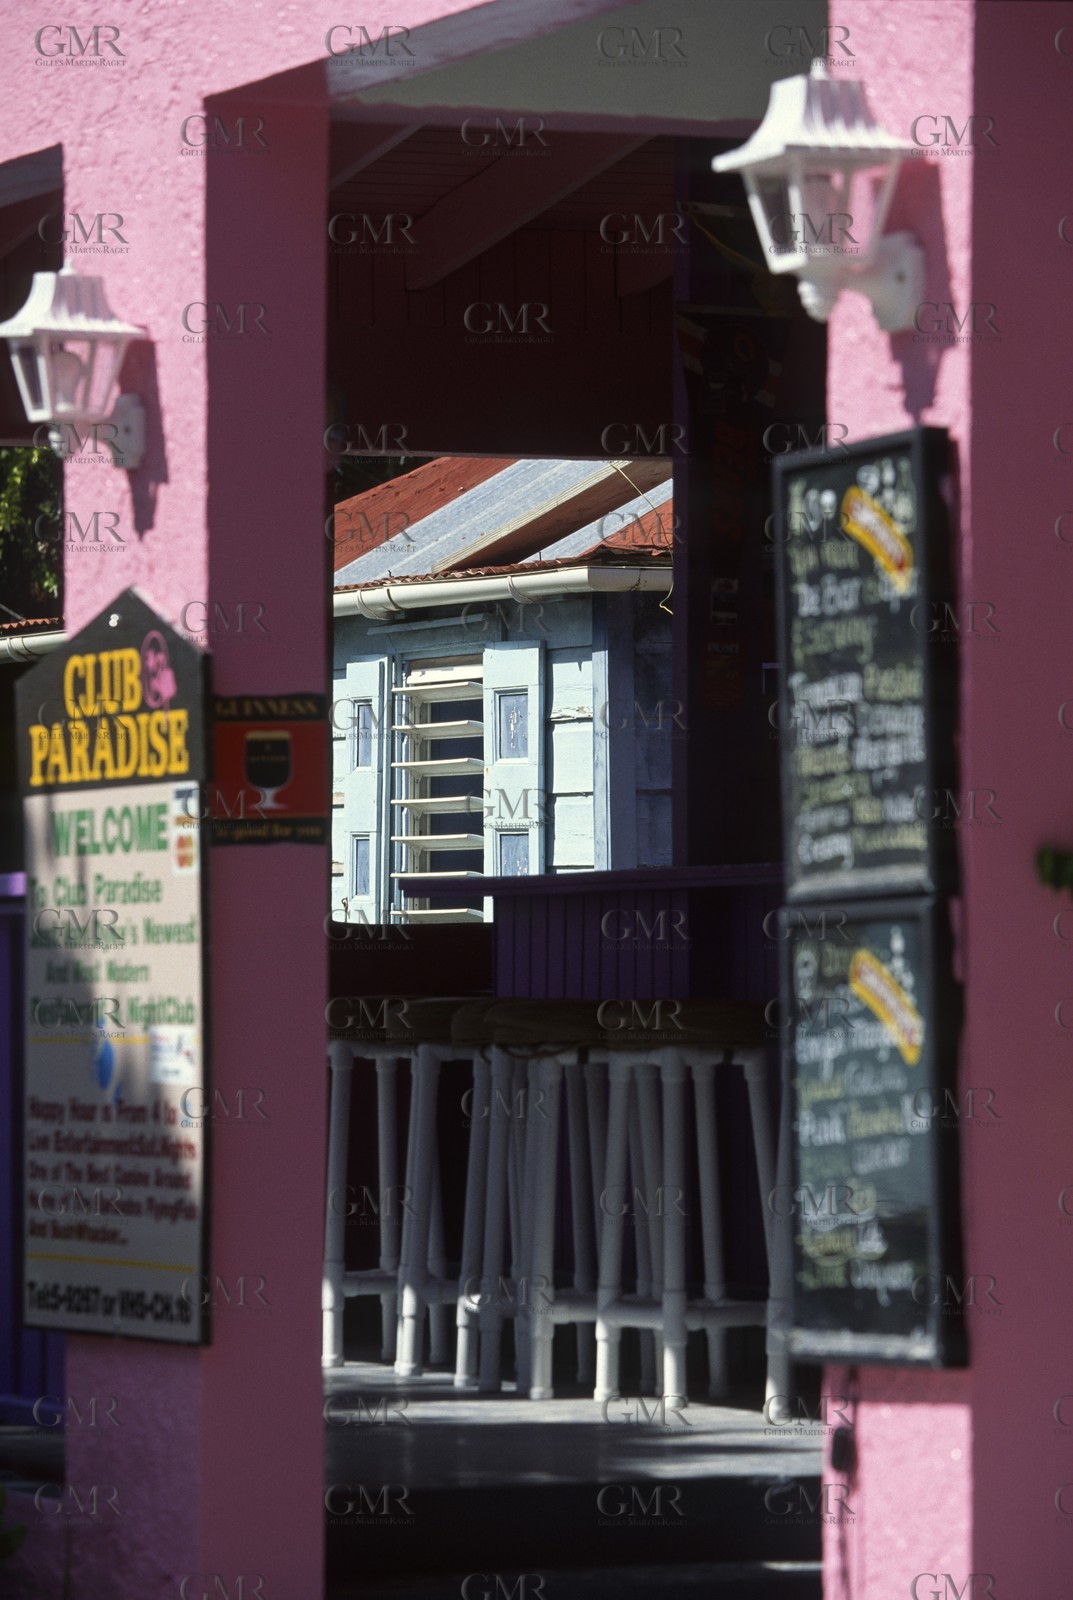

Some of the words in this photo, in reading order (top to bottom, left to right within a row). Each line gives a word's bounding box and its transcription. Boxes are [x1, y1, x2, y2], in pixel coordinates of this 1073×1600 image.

[64, 648, 143, 717] CLUB
[215, 698, 318, 717] GUINNESS
[28, 709, 189, 786] PARADISE
[51, 803, 169, 857] WELCOME
[54, 876, 86, 906] Club
[94, 872, 163, 905] Paradise
[144, 915, 197, 945] Newest
